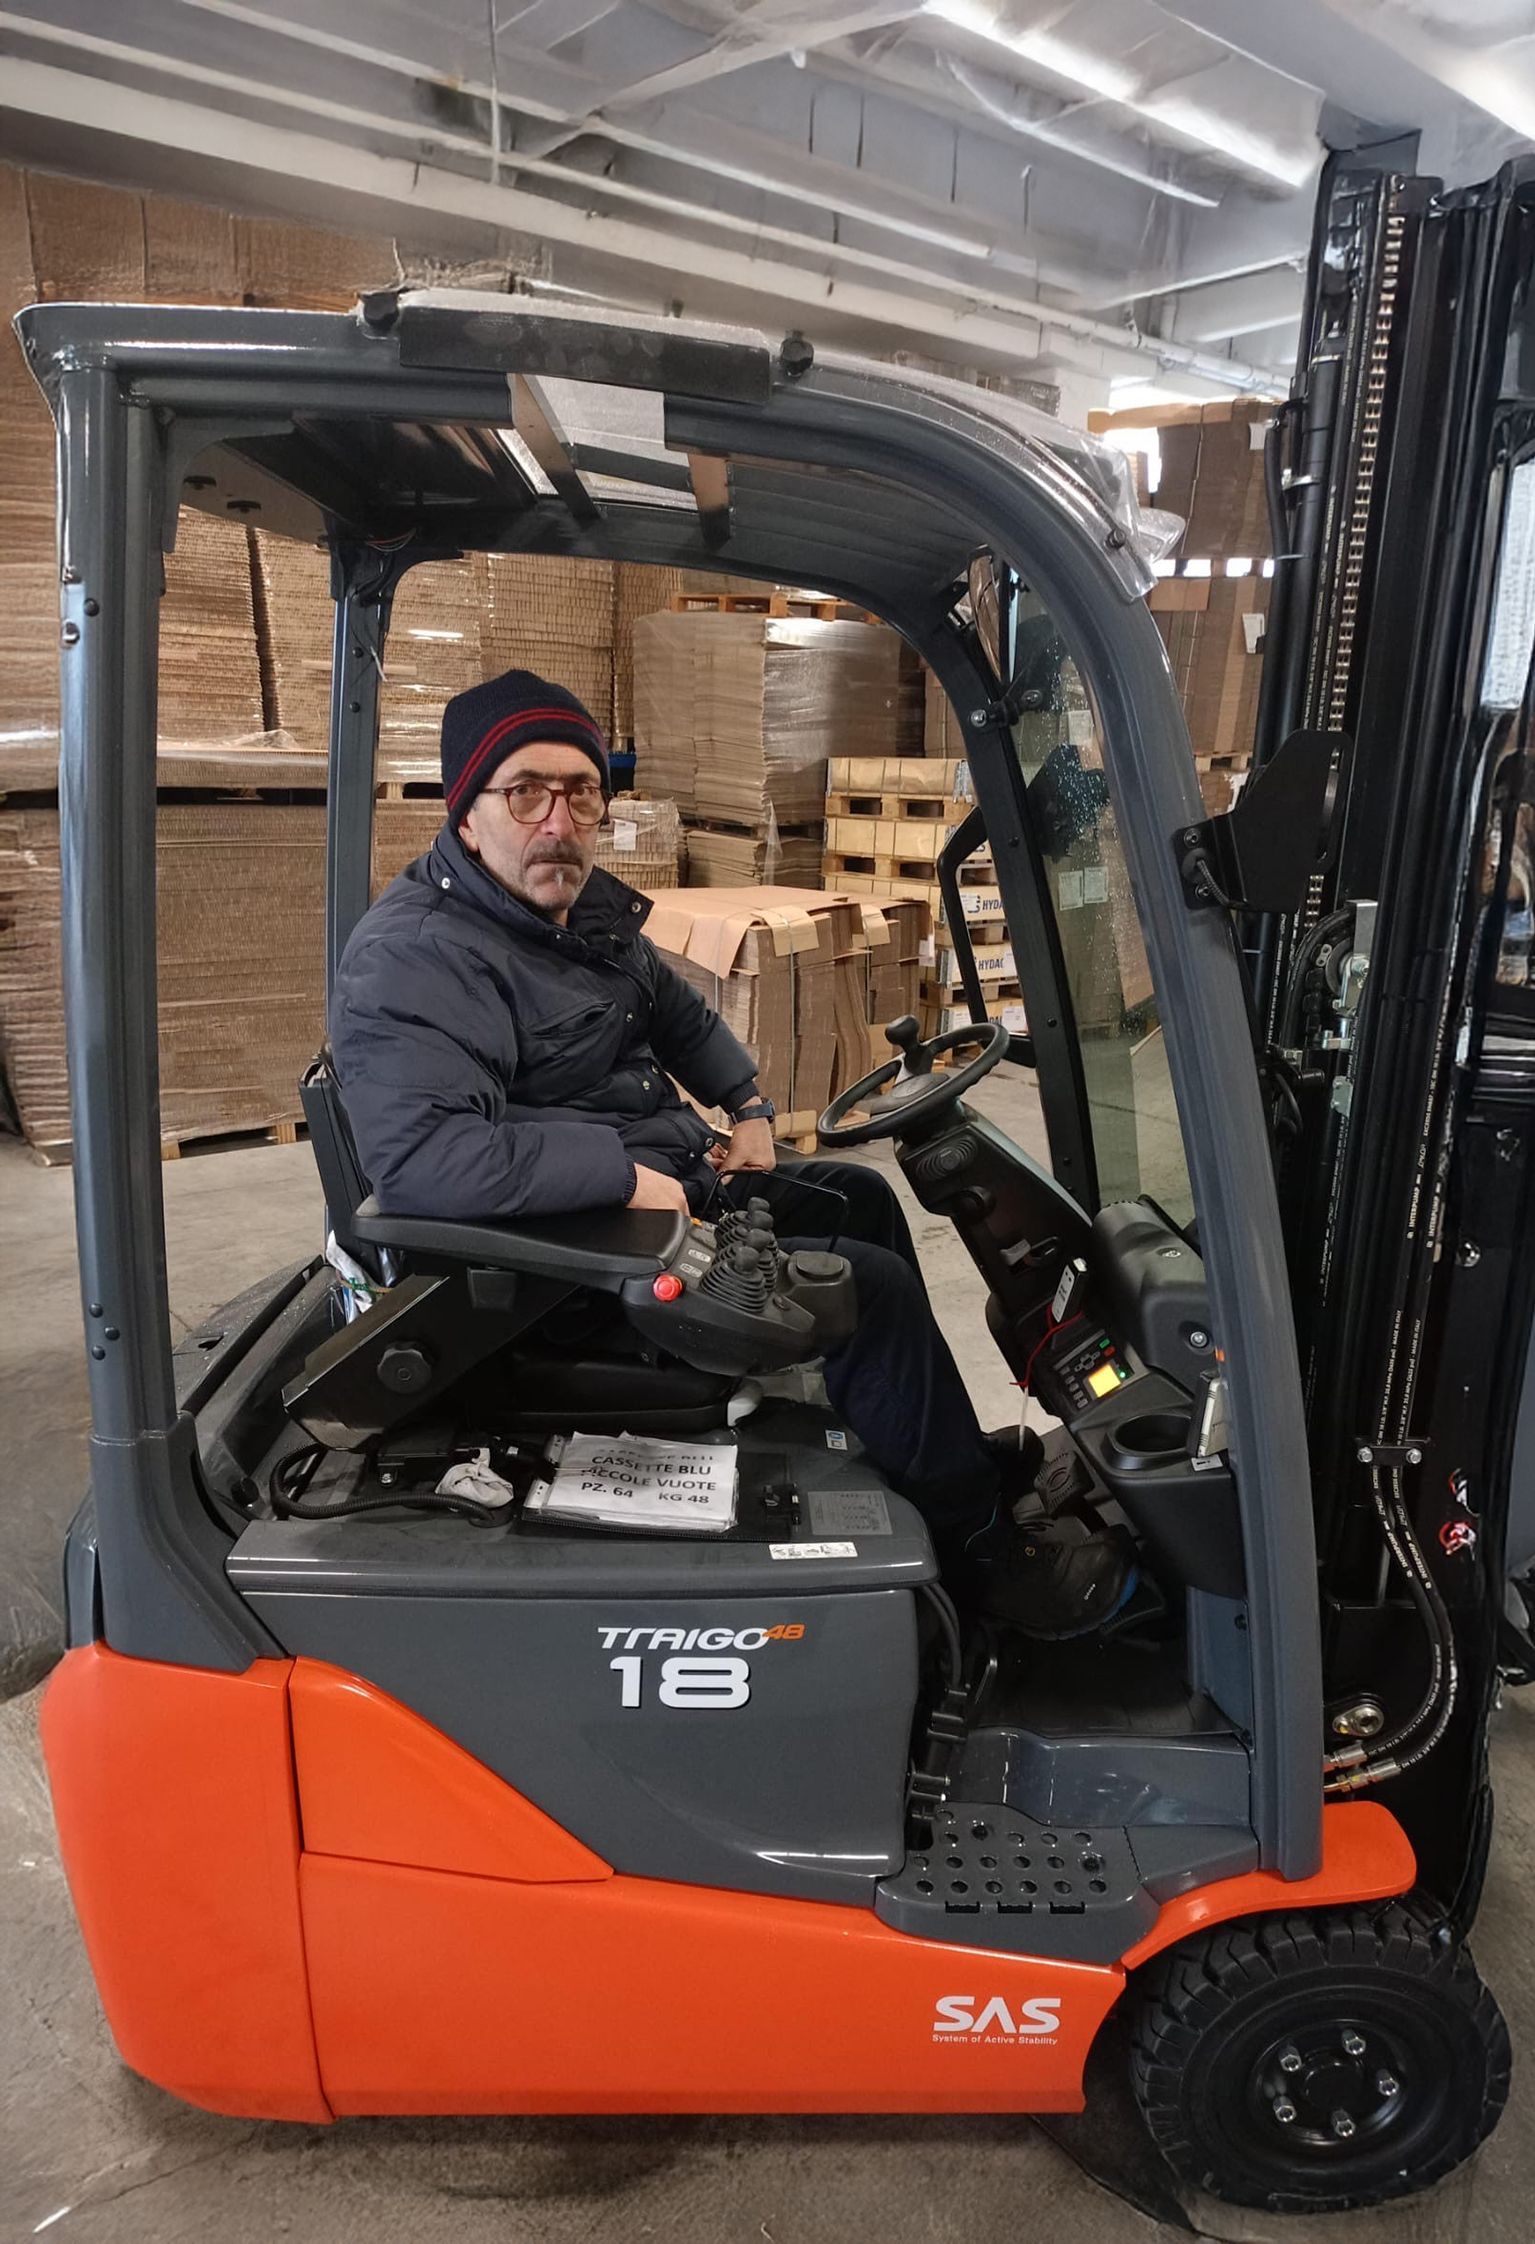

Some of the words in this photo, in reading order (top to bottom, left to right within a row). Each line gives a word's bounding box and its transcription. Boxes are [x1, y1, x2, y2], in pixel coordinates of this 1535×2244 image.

[678, 1465, 712, 1476] BLU
[581, 1482, 607, 1493] PZ.
[613, 1487, 633, 1498] 64
[658, 1493, 682, 1501] KG
[687, 1494, 710, 1504] 48
[656, 1478, 717, 1491] VUOTE
[610, 1656, 750, 1708] 18
[933, 1996, 1061, 2034] SAS
[932, 2034, 967, 2044] System
[972, 2035, 981, 2043] of
[984, 2035, 1015, 2044] Active
[1019, 2036, 1057, 2045] Stability
